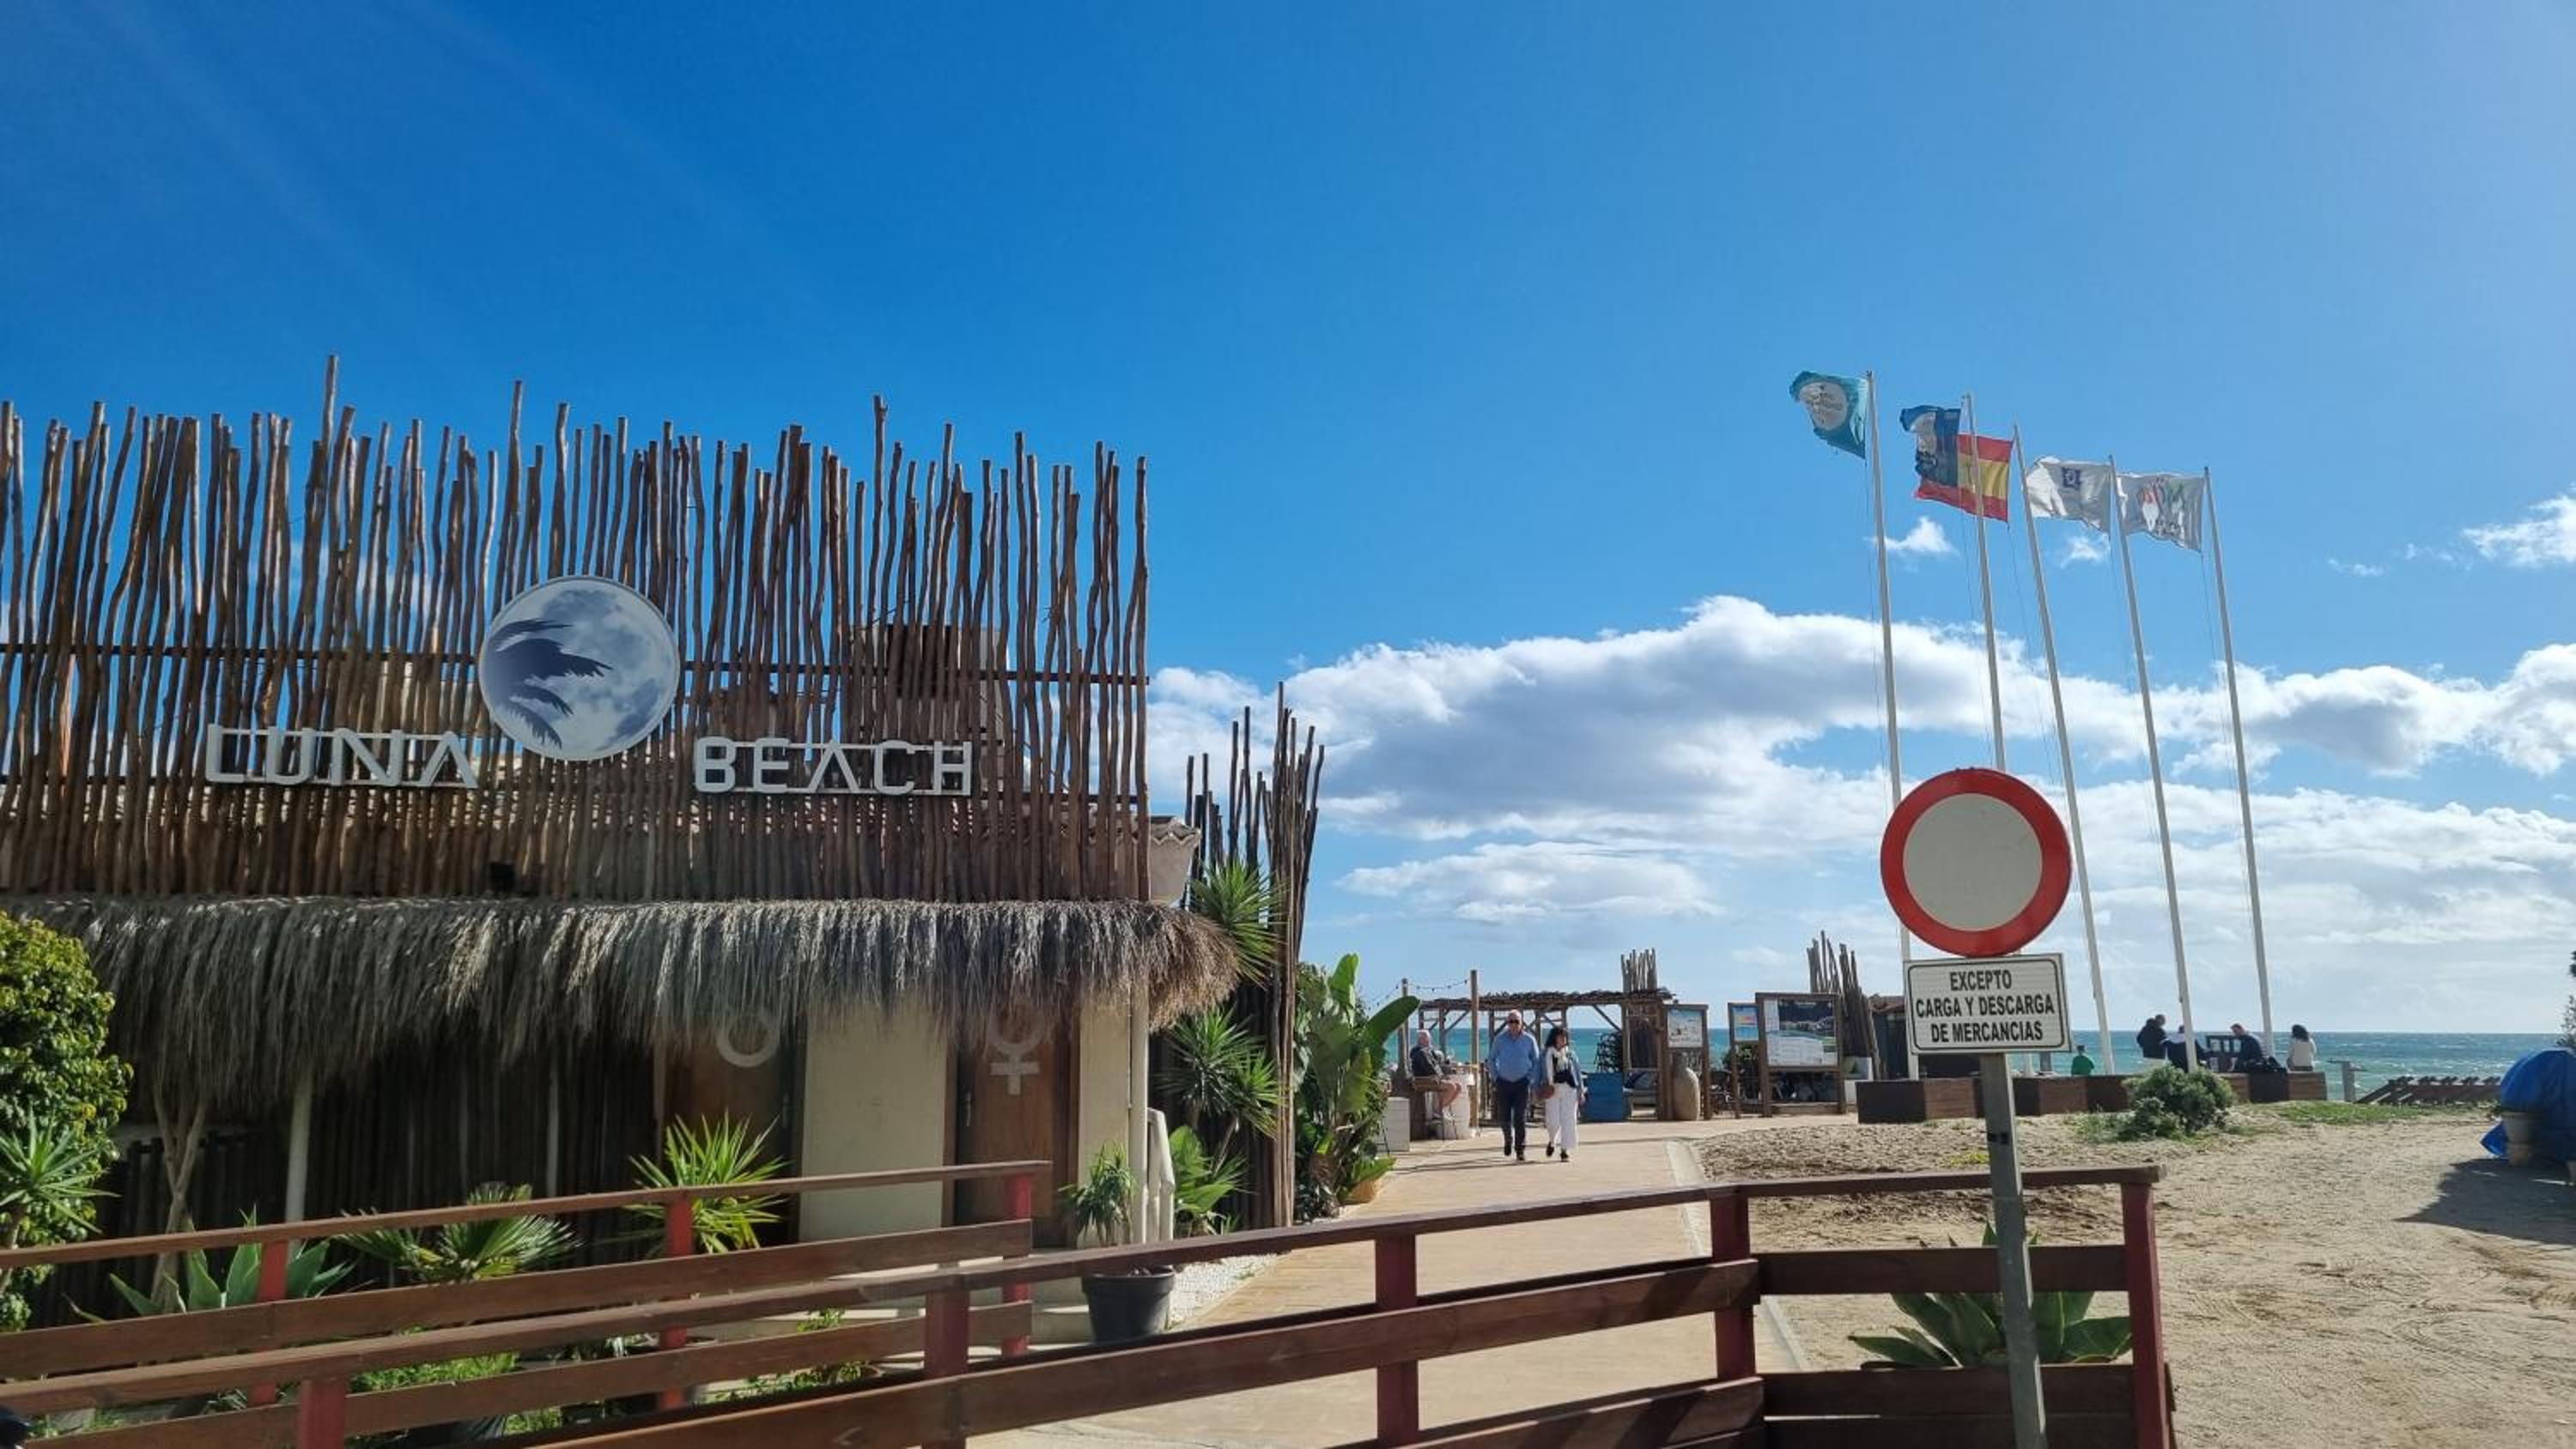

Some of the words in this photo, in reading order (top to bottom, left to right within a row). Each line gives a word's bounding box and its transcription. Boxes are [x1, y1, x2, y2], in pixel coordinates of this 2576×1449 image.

[205, 724, 478, 788] LUNA
[694, 737, 972, 796] BEACH
[1949, 969, 2012, 991] EXCEPTO
[1916, 997, 1962, 1018] CARGA
[1965, 997, 1975, 1016] Y
[1978, 993, 2055, 1016] DESCARGA
[1930, 1023, 1949, 1043] DE
[1952, 1021, 2043, 1042] MERCANCIAS
